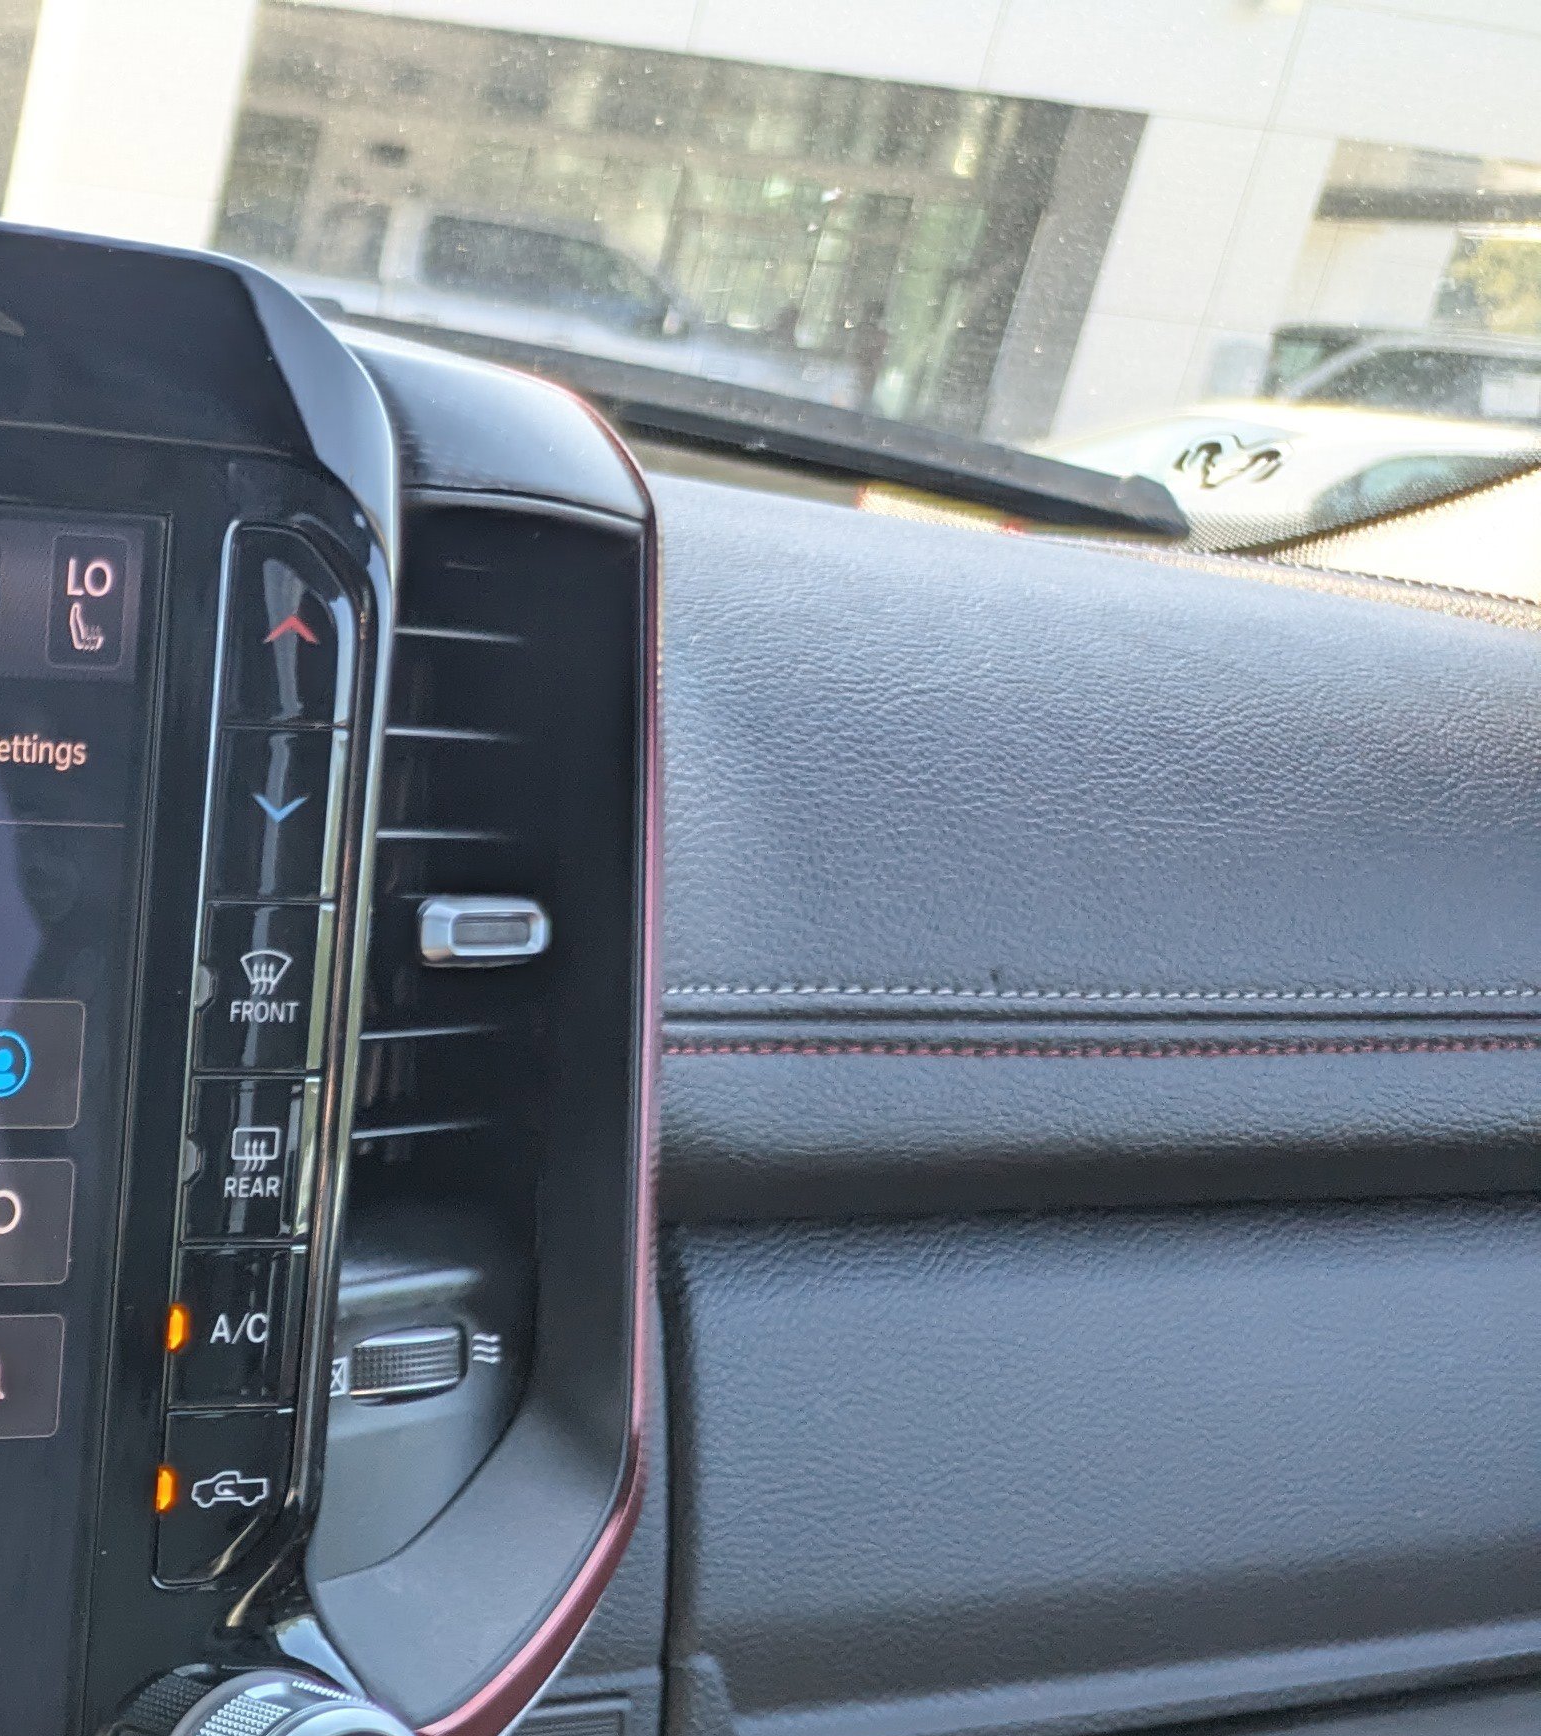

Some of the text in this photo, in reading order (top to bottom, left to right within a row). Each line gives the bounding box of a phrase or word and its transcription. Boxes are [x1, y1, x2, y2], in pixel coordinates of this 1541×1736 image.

[67, 556, 112, 597] LO
[230, 1000, 299, 1024] FRONT
[224, 1176, 281, 1200] REAR
[210, 1311, 269, 1345] A/C
